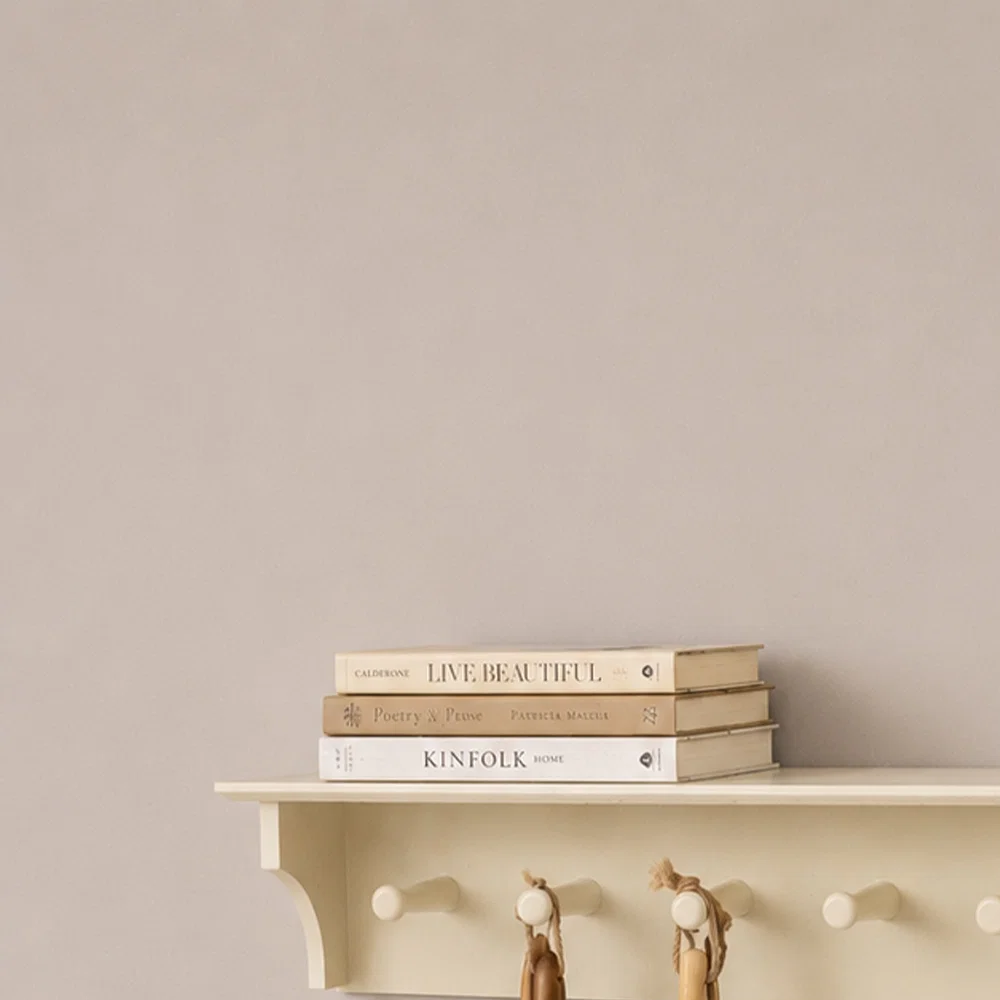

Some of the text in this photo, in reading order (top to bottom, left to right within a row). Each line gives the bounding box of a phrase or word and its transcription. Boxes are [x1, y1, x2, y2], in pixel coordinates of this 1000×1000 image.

[354, 669, 410, 678] CALDERONE
[427, 663, 477, 683] LIVE
[482, 663, 602, 683] BEAUTIFUL
[373, 707, 422, 726] Poetry
[423, 750, 564, 768] KINFOLK HOME
